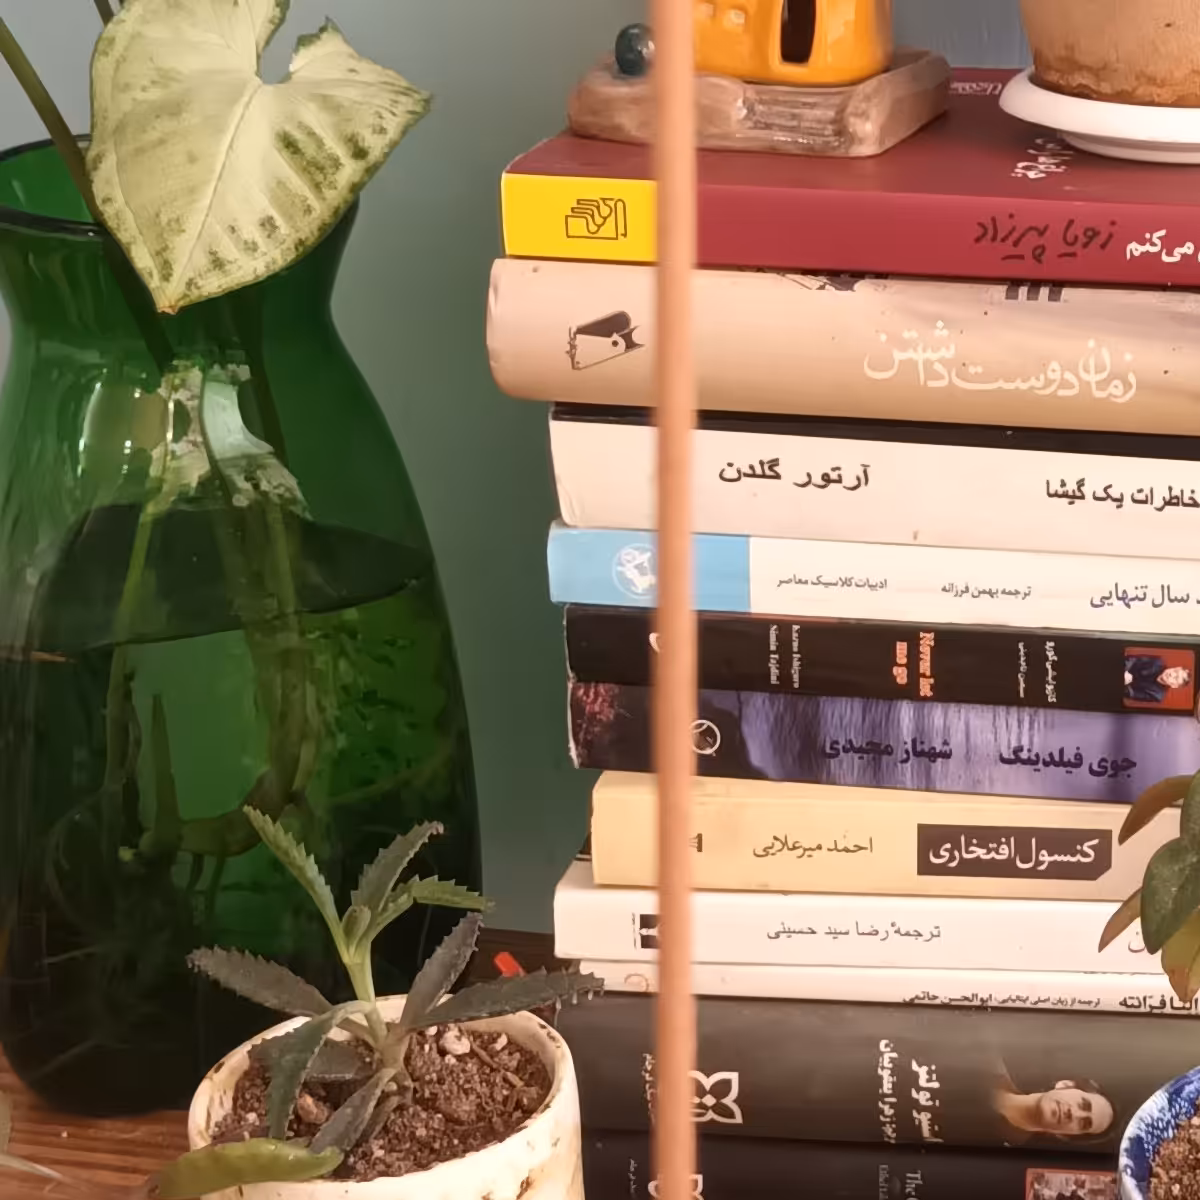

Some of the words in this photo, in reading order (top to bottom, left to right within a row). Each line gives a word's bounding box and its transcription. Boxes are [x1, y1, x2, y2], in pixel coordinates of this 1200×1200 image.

[974, 212, 1049, 264] پیرزاد
[1057, 219, 1117, 258] زویا
[1079, 338, 1137, 403] زمان
[718, 457, 782, 482] گلدن
[792, 463, 871, 491] آرتور
[1046, 477, 1086, 505] گیشا
[1092, 484, 1124, 509] یک
[1131, 485, 1200, 512] خاطرات
[777, 574, 809, 588] معاصر
[811, 575, 854, 589] کلاسیک
[854, 578, 887, 591] ادبیات
[941, 582, 970, 598] فرزانه
[971, 584, 999, 599] بهمن
[1000, 586, 1032, 600] ترجمه
[1090, 582, 1148, 609] تنهایی
[1151, 584, 1190, 608] سال
[769, 654, 780, 685] Tajdini
[825, 738, 894, 761] مجیدی
[899, 737, 953, 764] شهناز
[999, 744, 1084, 774] فیلدینگ
[1088, 755, 1137, 778] جوی
[752, 834, 823, 859] میرعلایی
[827, 836, 873, 854] احمد
[929, 835, 1014, 868] افتخاری
[1015, 837, 1100, 870] کنسول
[767, 922, 817, 941] حسینی
[824, 923, 851, 940] سید
[855, 921, 888, 942] رضا
